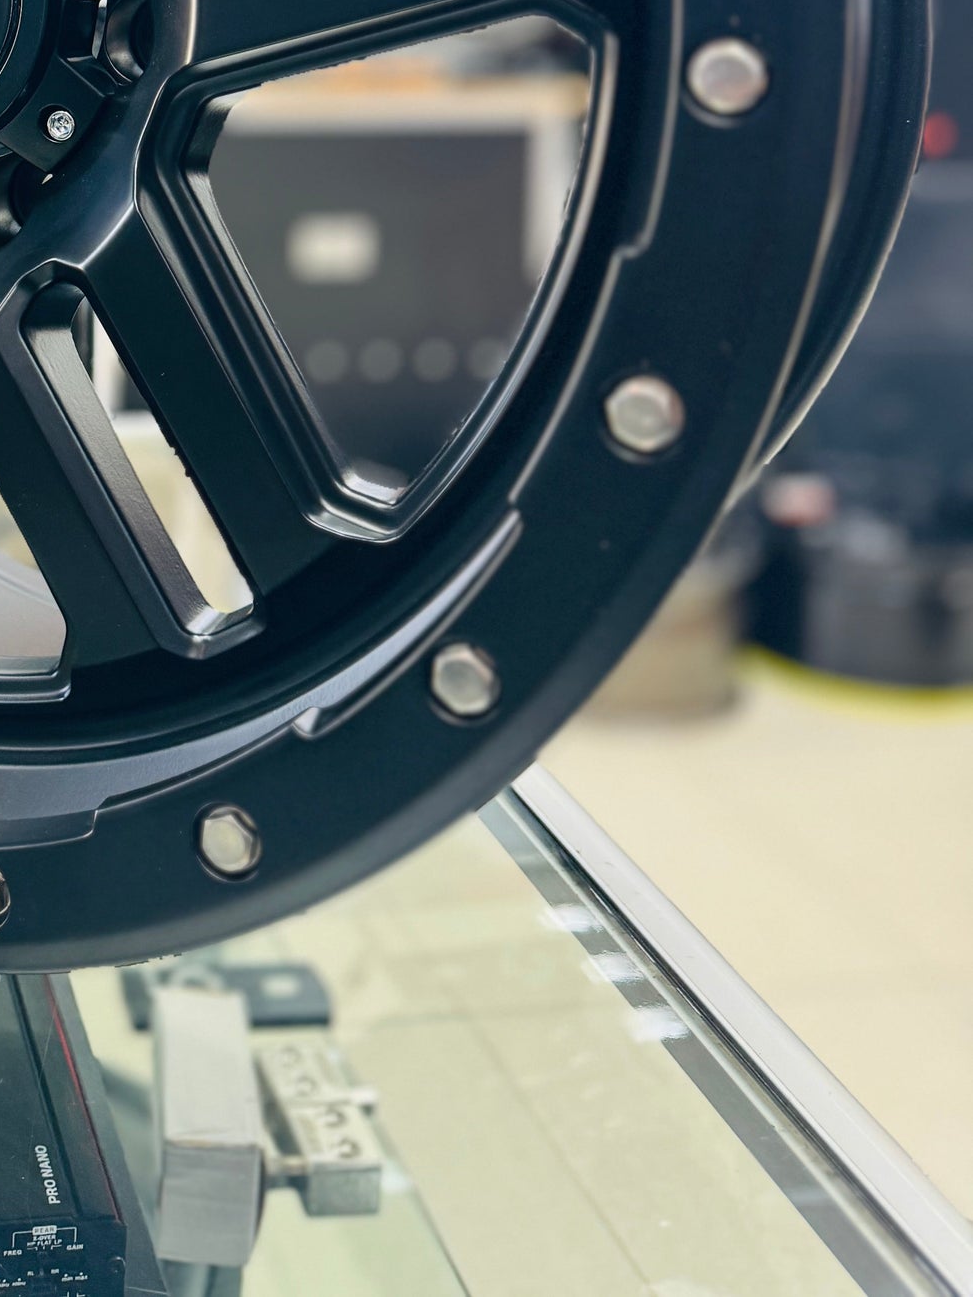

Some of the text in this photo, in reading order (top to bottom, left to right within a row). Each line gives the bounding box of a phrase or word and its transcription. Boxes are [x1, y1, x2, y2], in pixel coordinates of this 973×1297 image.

[34, 1145, 61, 1204] PRO NANO
[3, 1249, 23, 1257] FREQ
